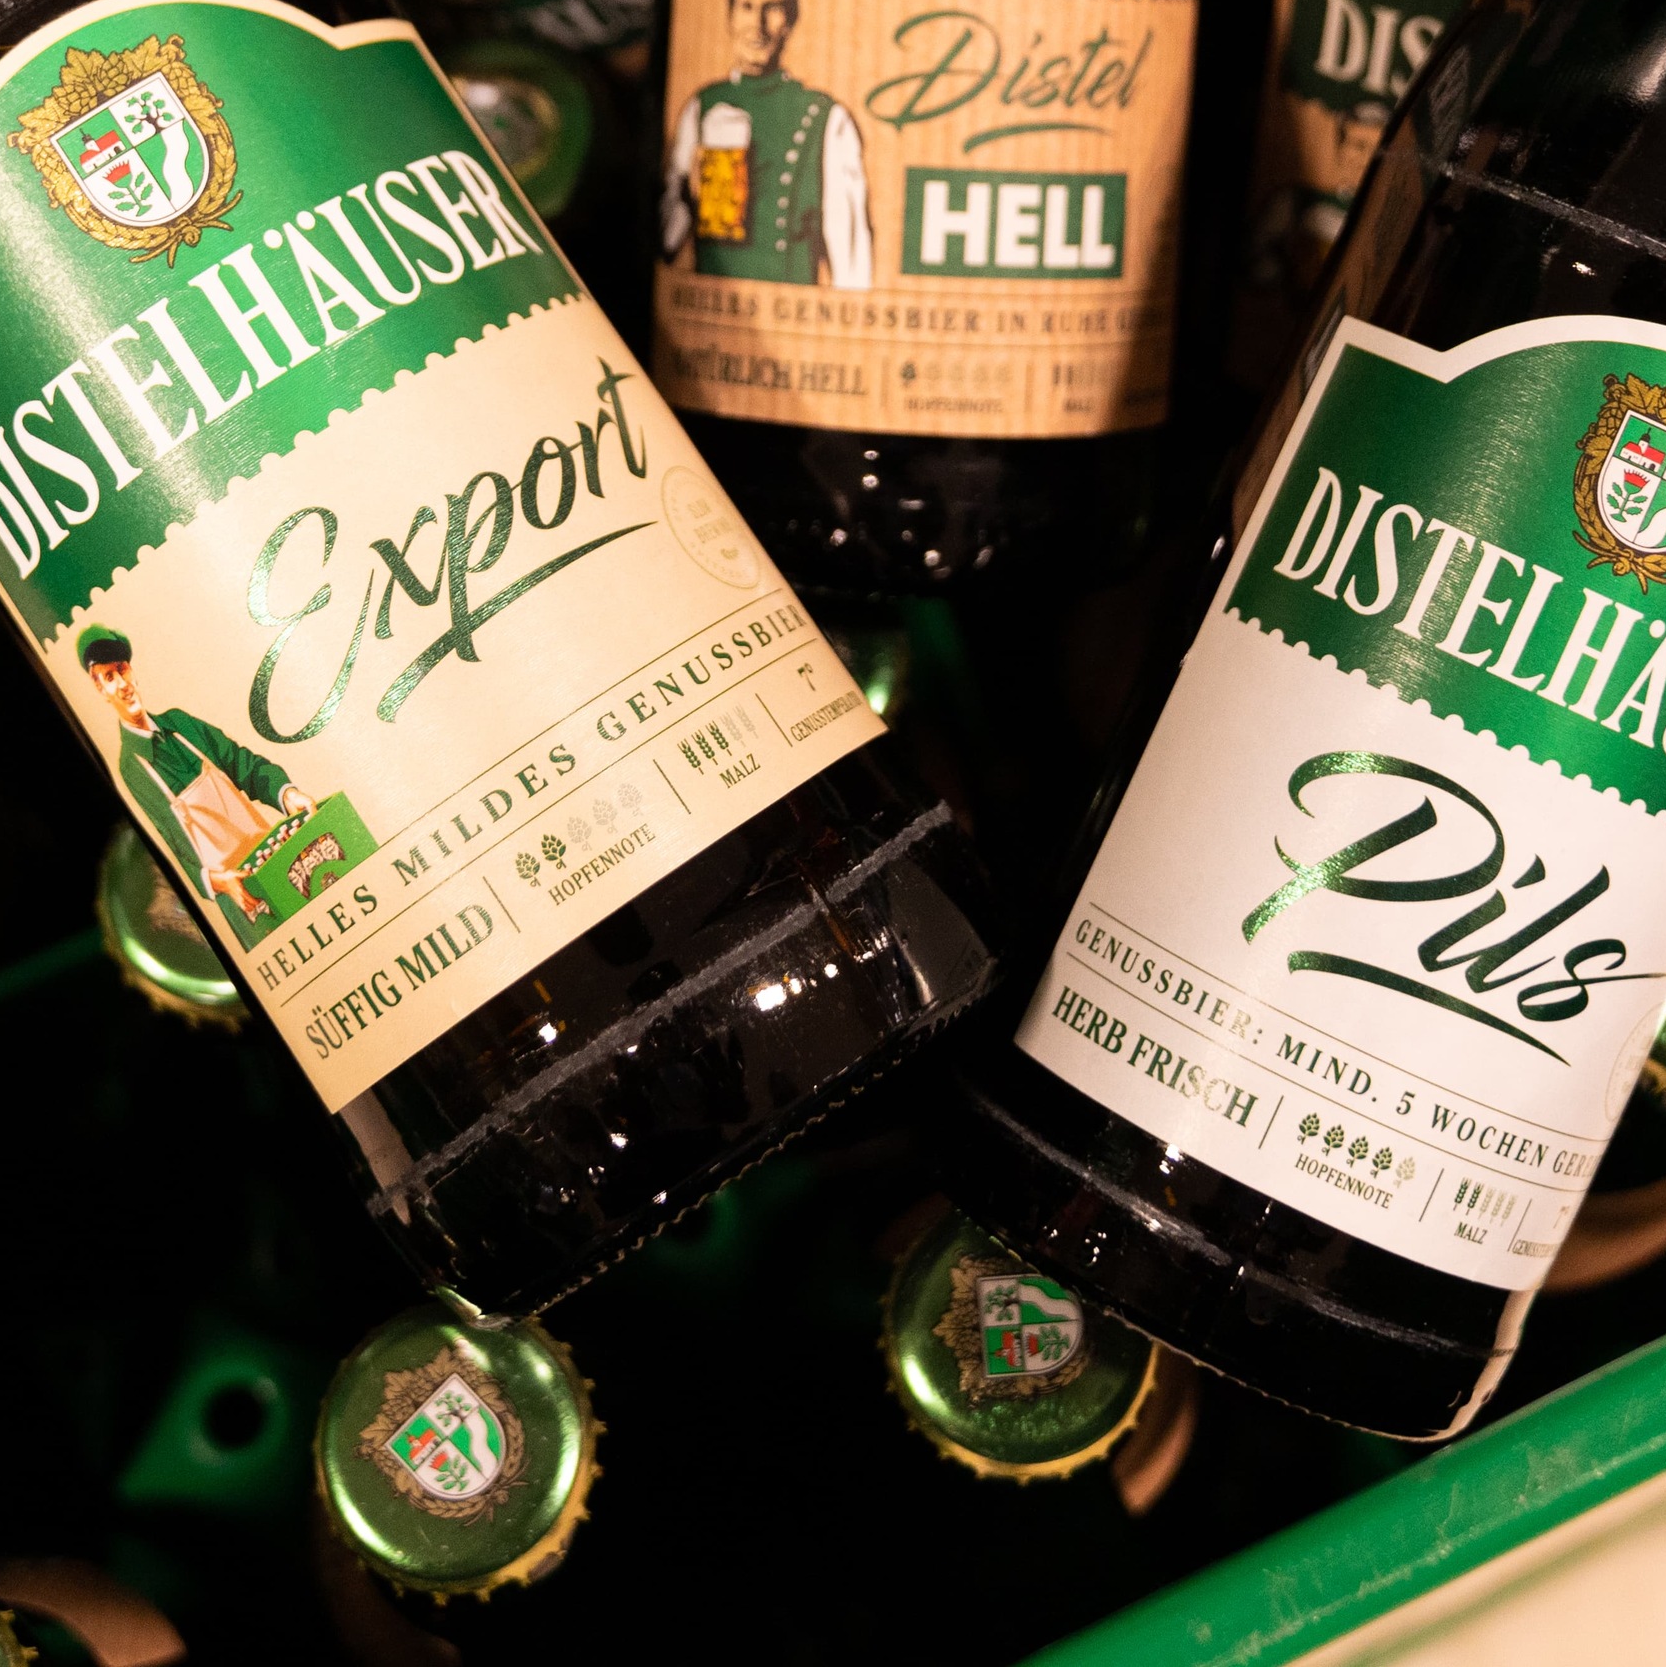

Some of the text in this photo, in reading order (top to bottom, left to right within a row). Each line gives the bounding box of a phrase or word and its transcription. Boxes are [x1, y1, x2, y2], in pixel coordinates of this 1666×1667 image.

[863, 8, 1154, 132] Distel
[919, 179, 1117, 269] HELL
[772, 294, 982, 333] GENUSSBIER
[997, 309, 1027, 334] IN
[796, 359, 870, 397] HELL
[246, 354, 655, 746] Export
[255, 603, 808, 992] HELLES MILDES GENUSSBIER
[719, 753, 761, 789] MALZ
[547, 822, 658, 907] HOPFENNOTE
[304, 902, 494, 1061] SÜFFIG MILD
[1051, 985, 1259, 1129] HERB FRISCH
[1074, 918, 1264, 1046] GENUSSBIER:
[1275, 1032, 1378, 1103] MIND.
[1394, 1090, 1416, 1116] 5
[1431, 1103, 1550, 1168] WOCHEN
[1294, 1152, 1394, 1210] HOPFENNOTE
[1454, 1221, 1489, 1246] MALZ
